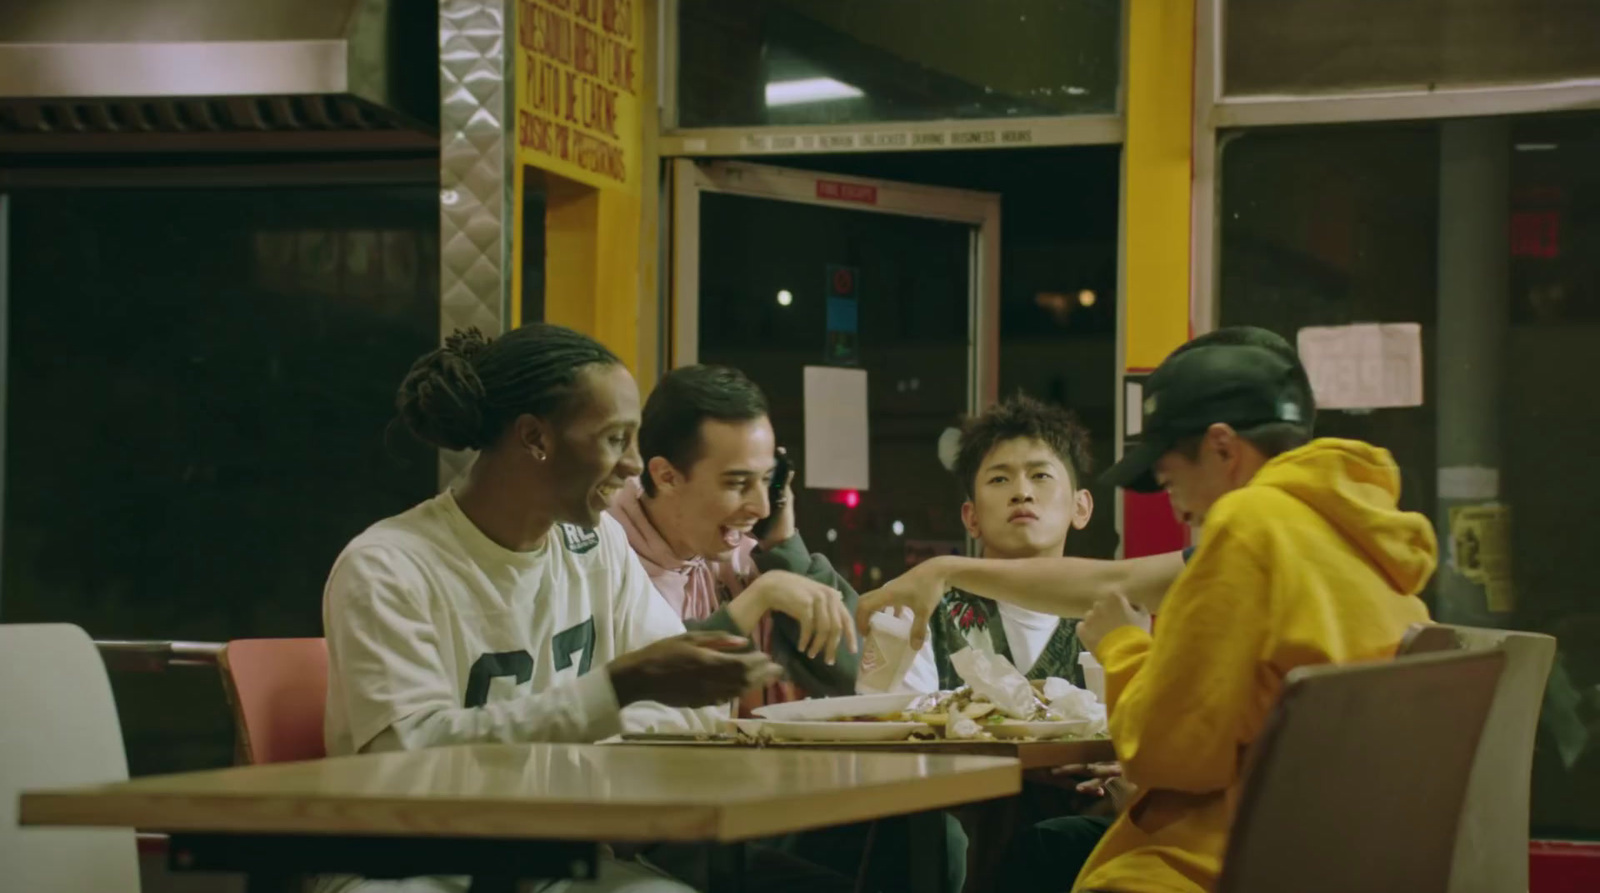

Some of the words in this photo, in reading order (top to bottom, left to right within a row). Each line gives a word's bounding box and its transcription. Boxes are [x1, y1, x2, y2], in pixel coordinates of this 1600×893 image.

[911, 132, 945, 146] DURING
[951, 131, 996, 145] BUSINESS
[1001, 129, 1033, 143] HOURS
